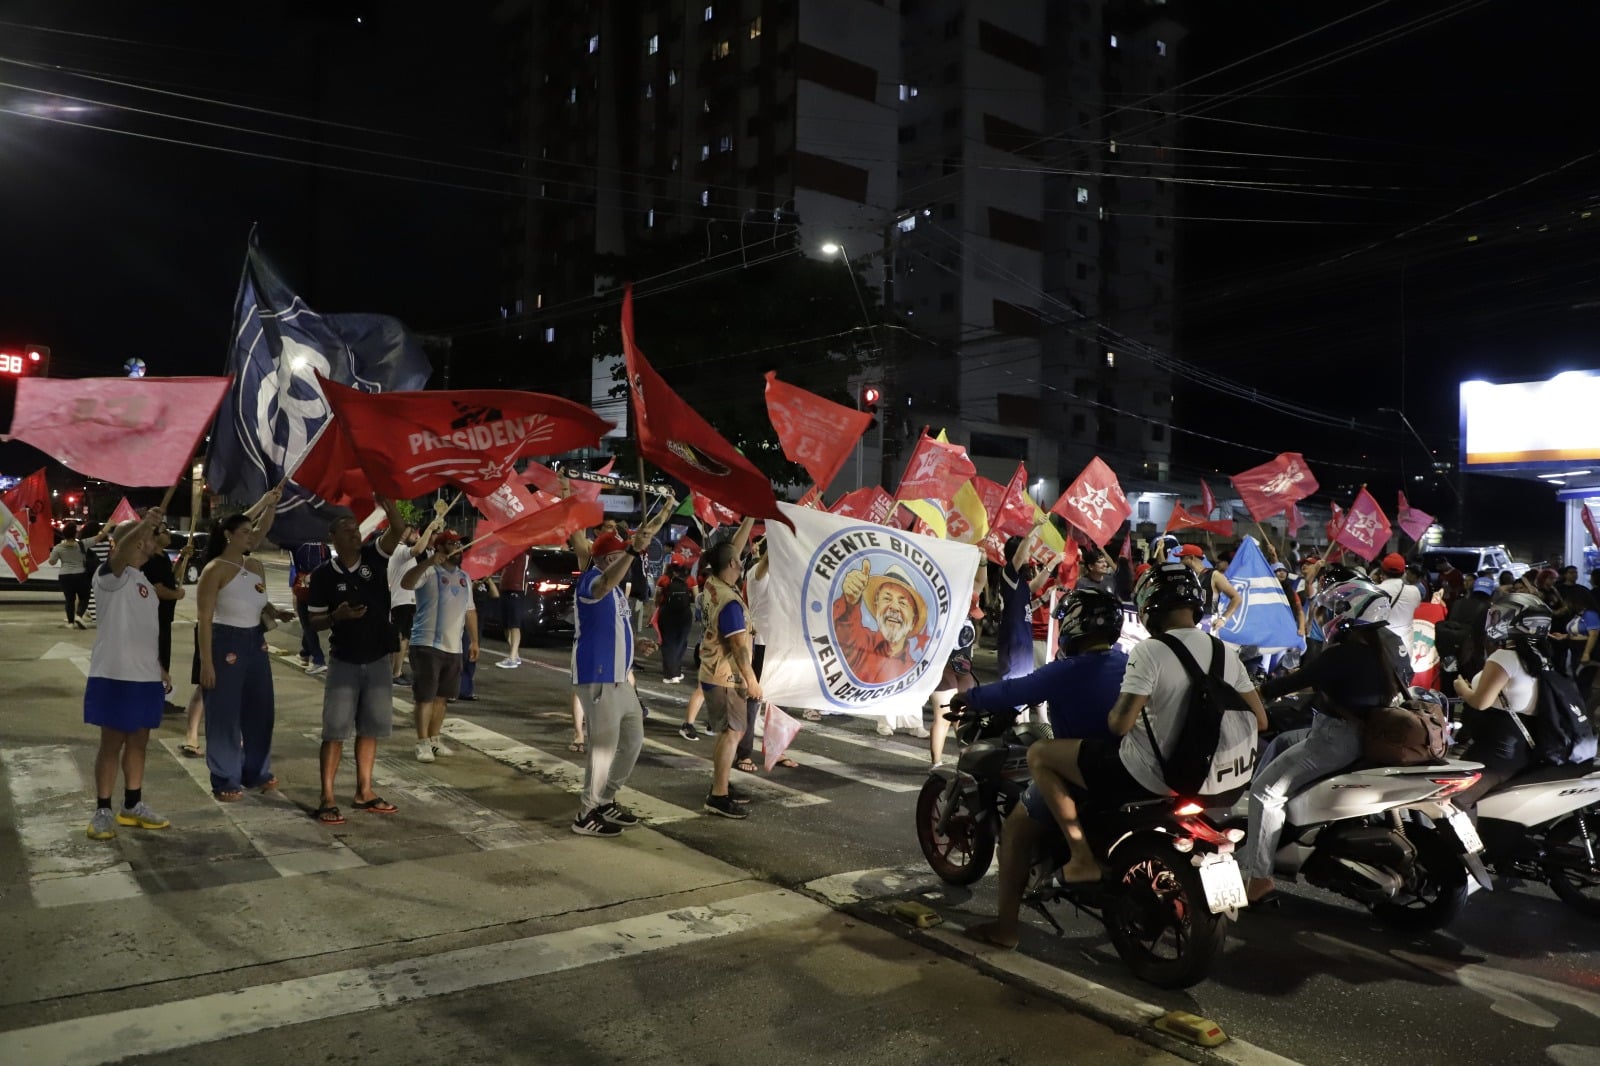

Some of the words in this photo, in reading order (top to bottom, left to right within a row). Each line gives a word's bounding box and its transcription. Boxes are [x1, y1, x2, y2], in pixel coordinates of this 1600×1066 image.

[0, 354, 23, 374] 38
[582, 472, 616, 485] REMO
[619, 479, 657, 493] ANTFA
[1361, 516, 1377, 530] 13
[1344, 523, 1374, 548] LULA
[815, 531, 881, 581] FRENTE
[889, 536, 949, 616] BICOLOR
[833, 658, 930, 703] DEMOCRACIA
